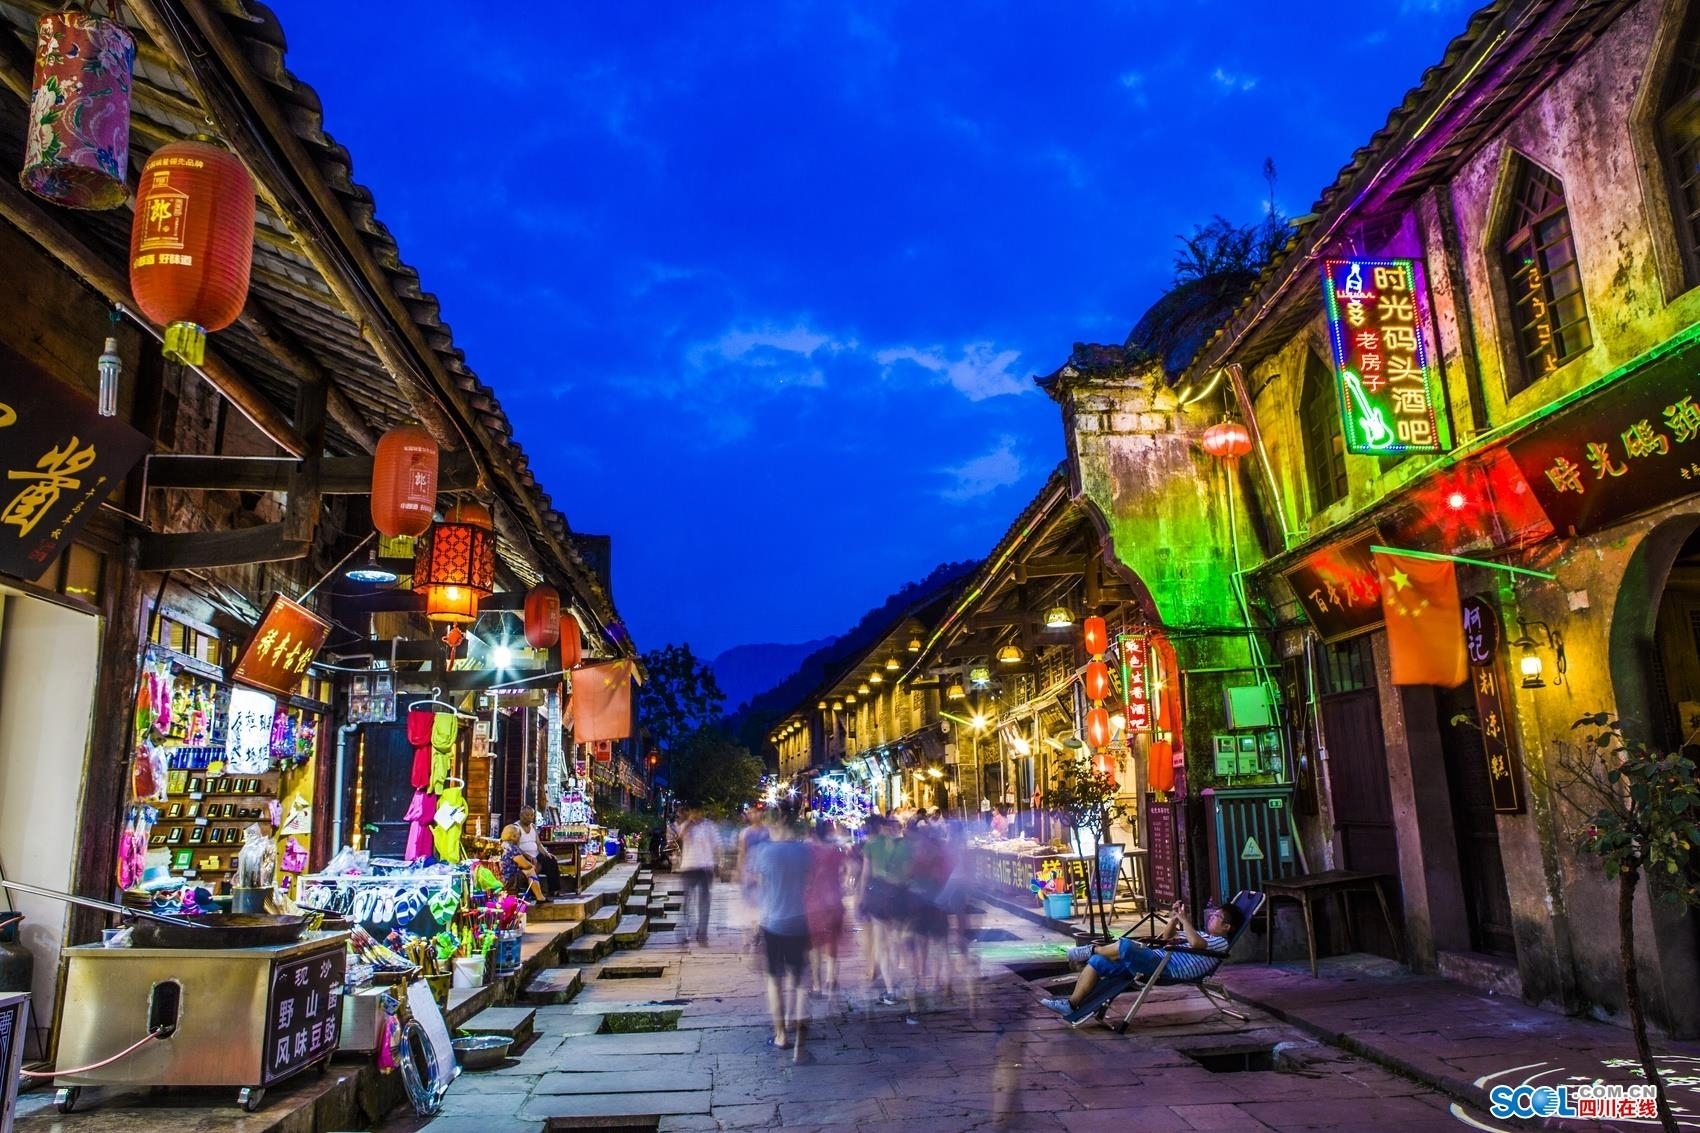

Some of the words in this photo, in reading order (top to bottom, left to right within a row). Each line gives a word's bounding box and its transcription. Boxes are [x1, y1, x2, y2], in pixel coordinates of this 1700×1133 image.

[150, 198, 172, 232] 郎
[158, 253, 193, 267] 好味道
[1354, 331, 1386, 393] 老房子
[1373, 266, 1433, 446] 时光码头酒吧
[294, 958, 332, 987] 现炒
[277, 980, 340, 1031] 野山菌
[274, 1015, 337, 1069] 风味豆豉
